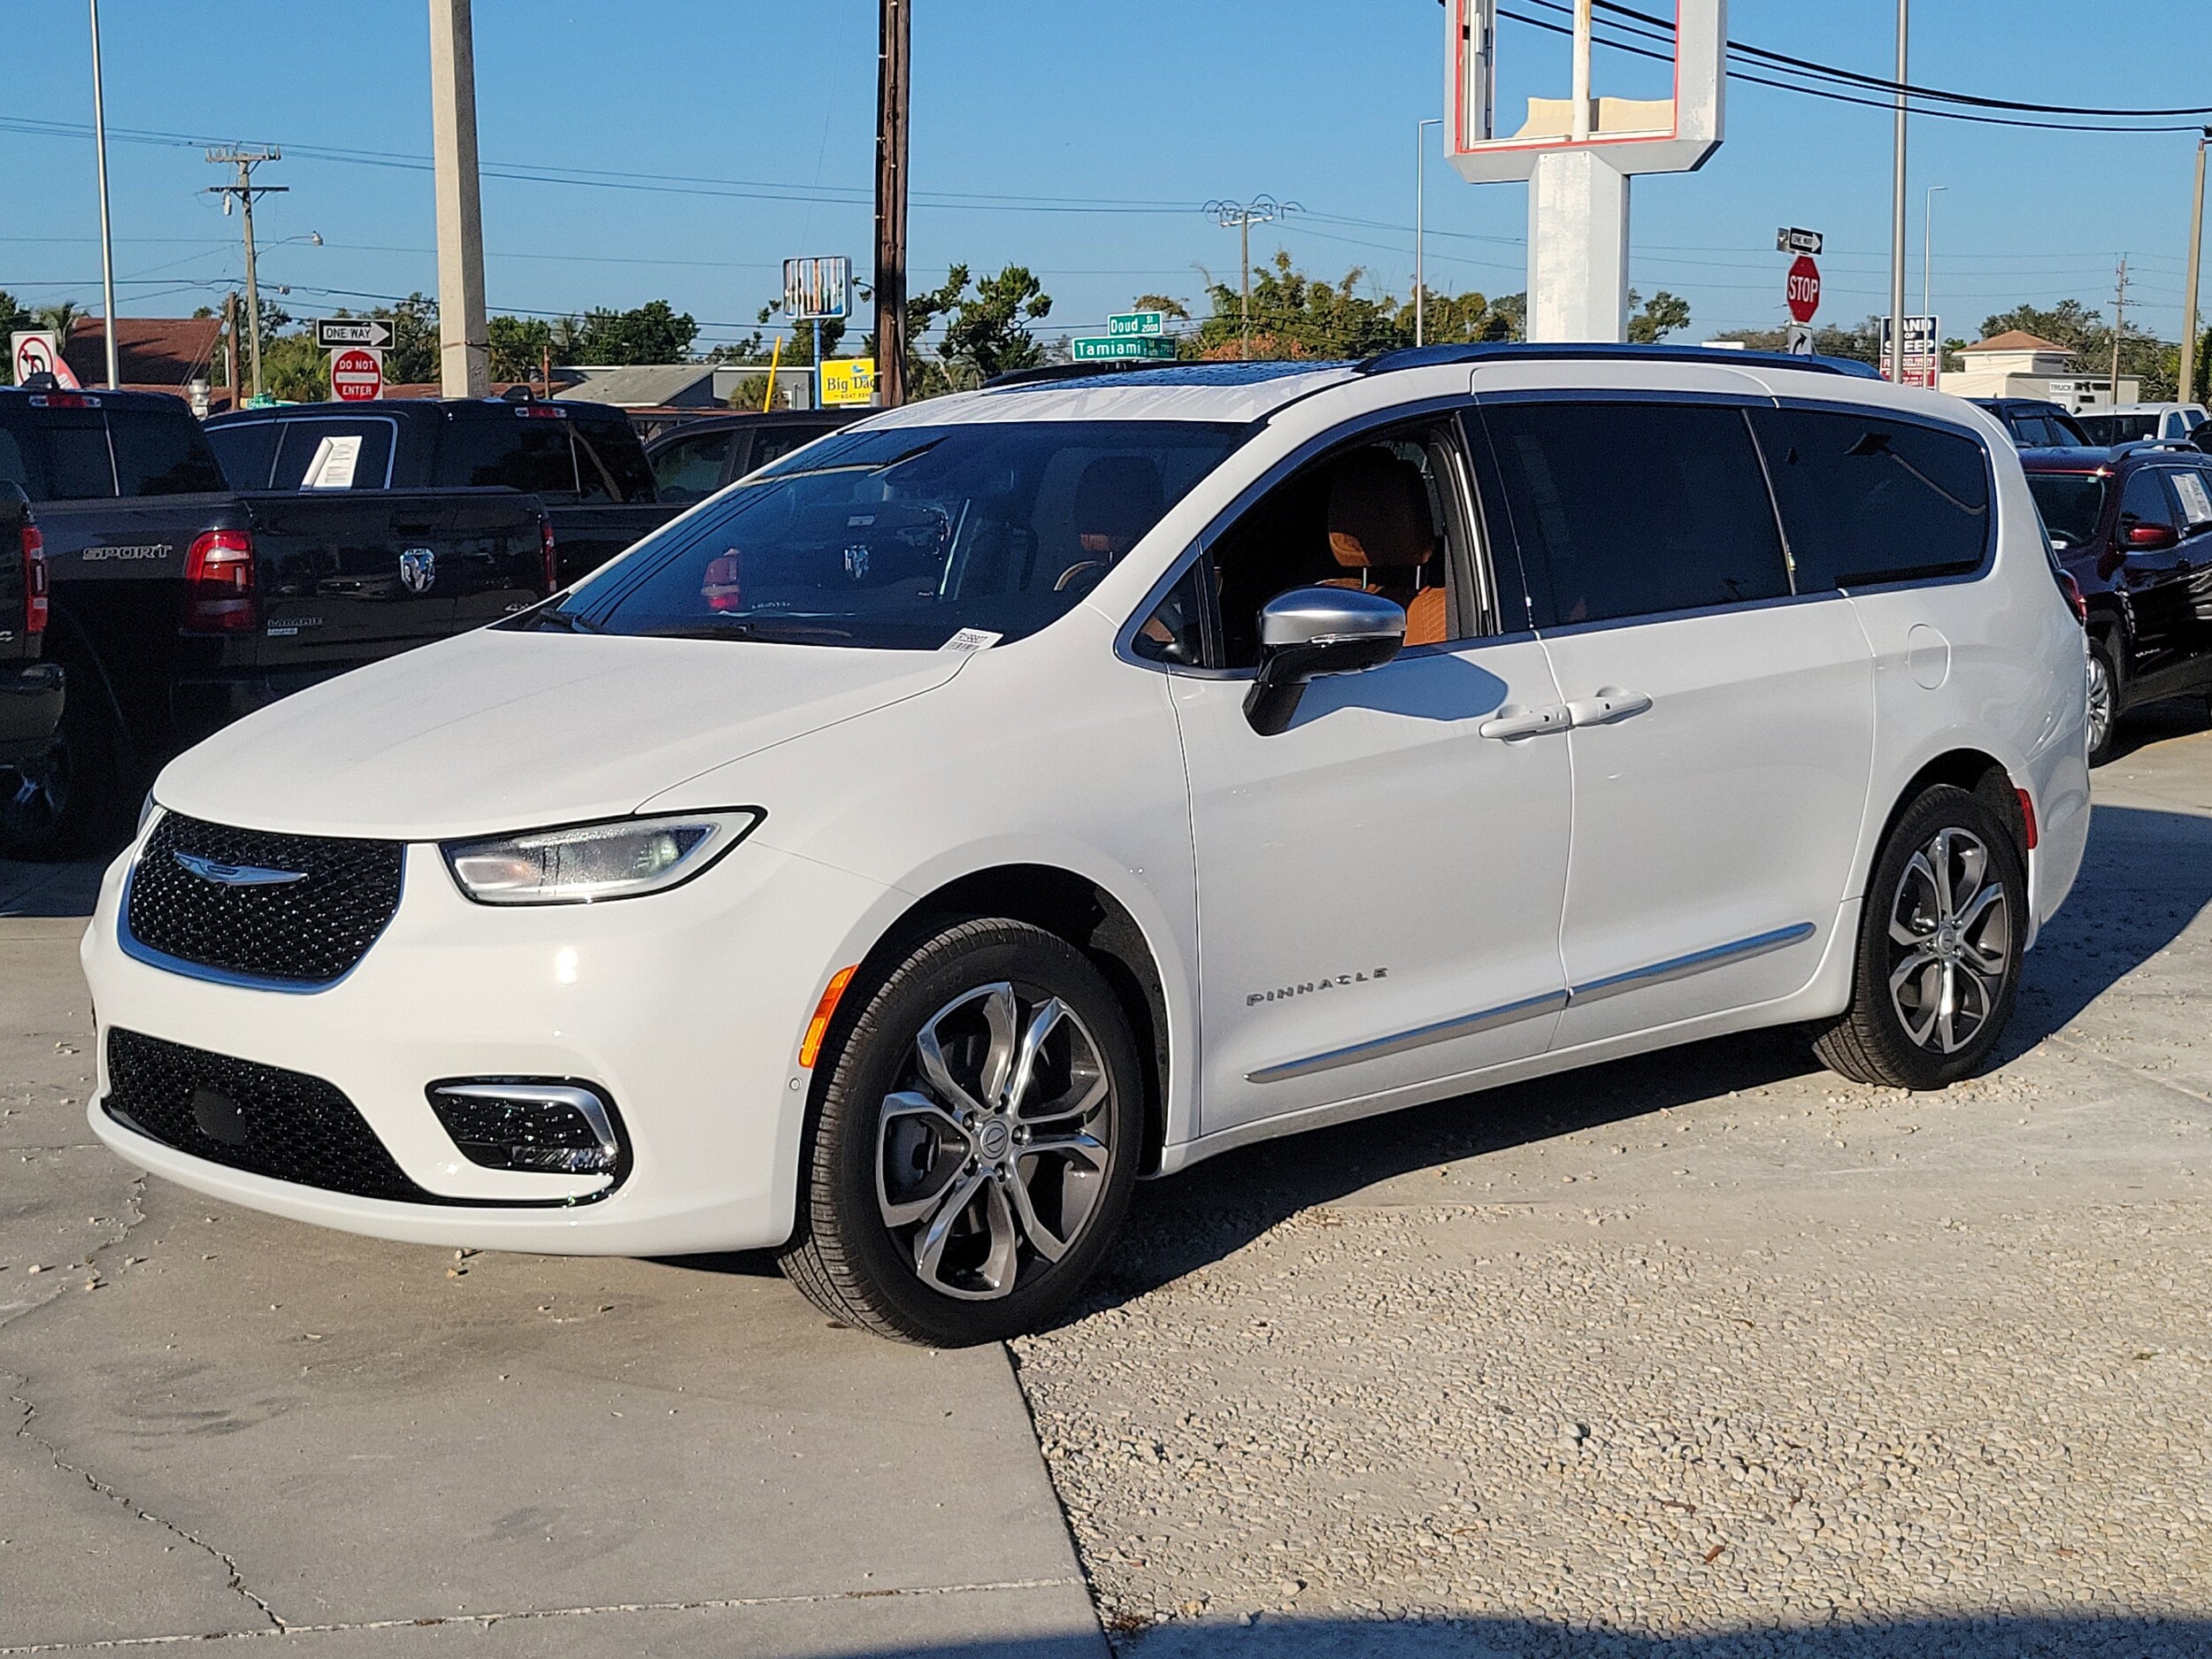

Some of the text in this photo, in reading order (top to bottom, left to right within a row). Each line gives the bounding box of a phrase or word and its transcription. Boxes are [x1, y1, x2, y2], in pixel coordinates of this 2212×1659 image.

[1788, 275, 1818, 303] STOP
[1110, 319, 1138, 333] Doud
[1889, 319, 1933, 332] AND
[326, 327, 371, 339] ONE WAY
[1077, 341, 1141, 357] Tamiami
[1884, 340, 1934, 353] SEEP
[339, 360, 373, 370] DO NOT
[342, 386, 372, 396] ENTER
[827, 377, 848, 393] Big
[83, 544, 173, 560] SPORT
[1247, 967, 1388, 1007] PINNACLE
